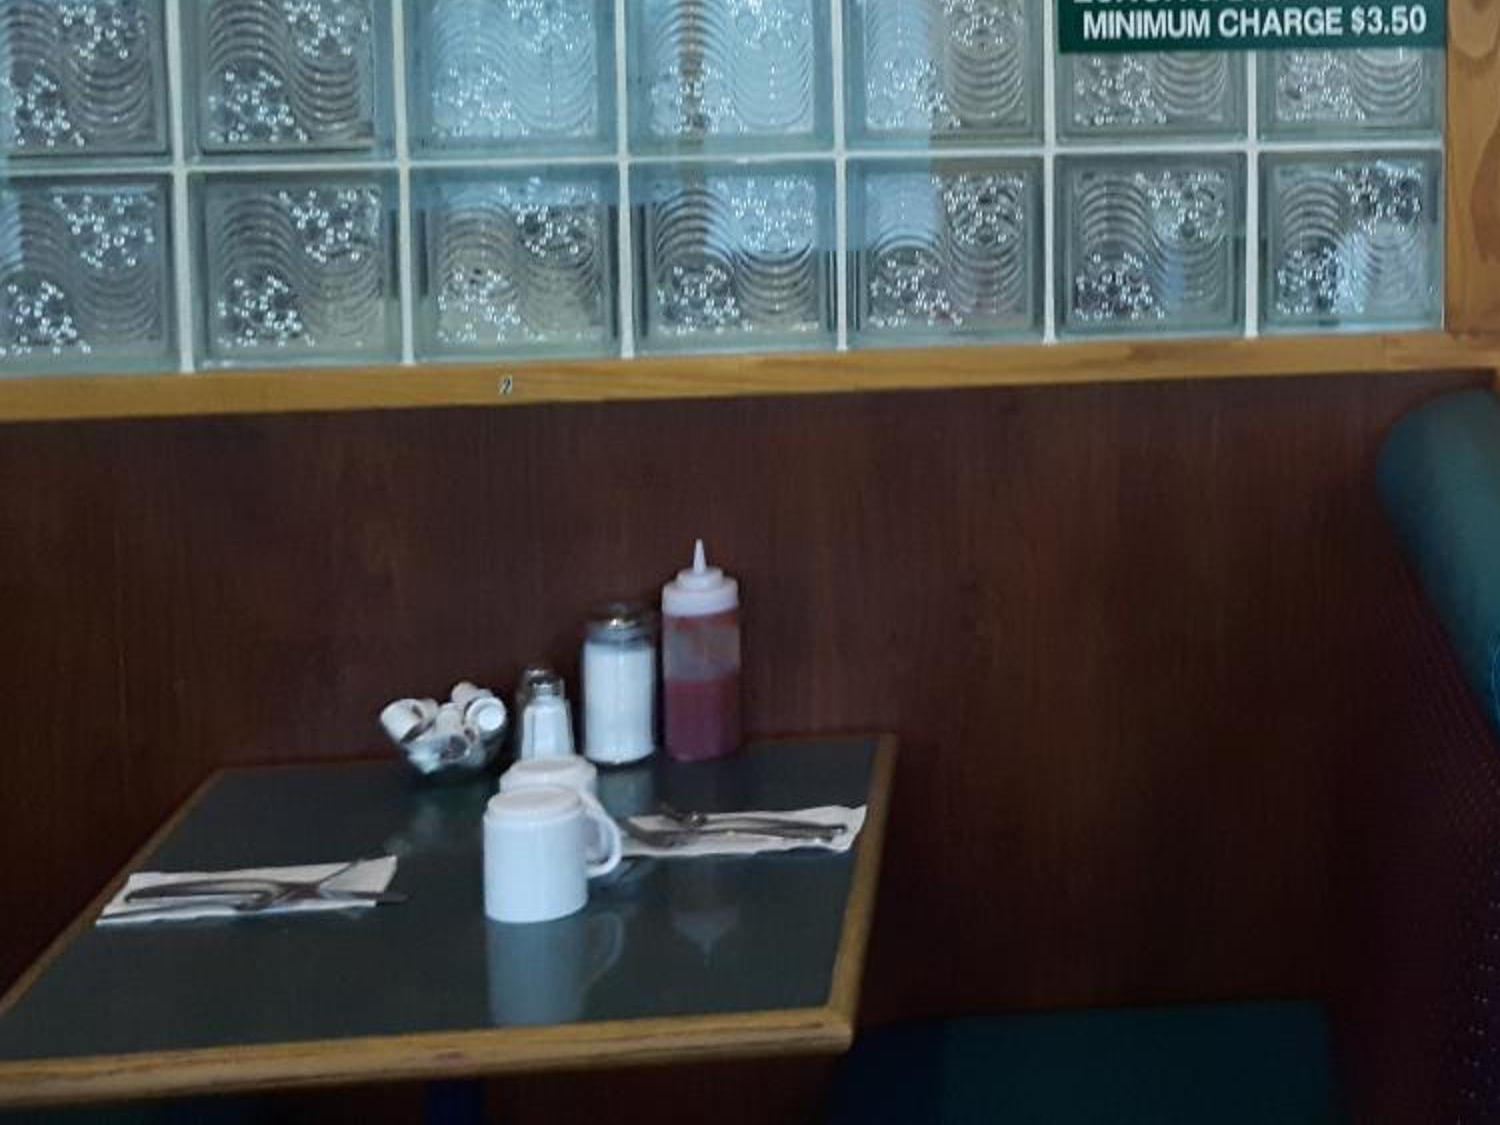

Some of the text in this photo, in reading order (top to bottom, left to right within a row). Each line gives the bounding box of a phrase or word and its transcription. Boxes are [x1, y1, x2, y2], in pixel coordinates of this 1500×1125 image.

[1083, 4, 1428, 40] MINIMUM CHARGE $3.50
